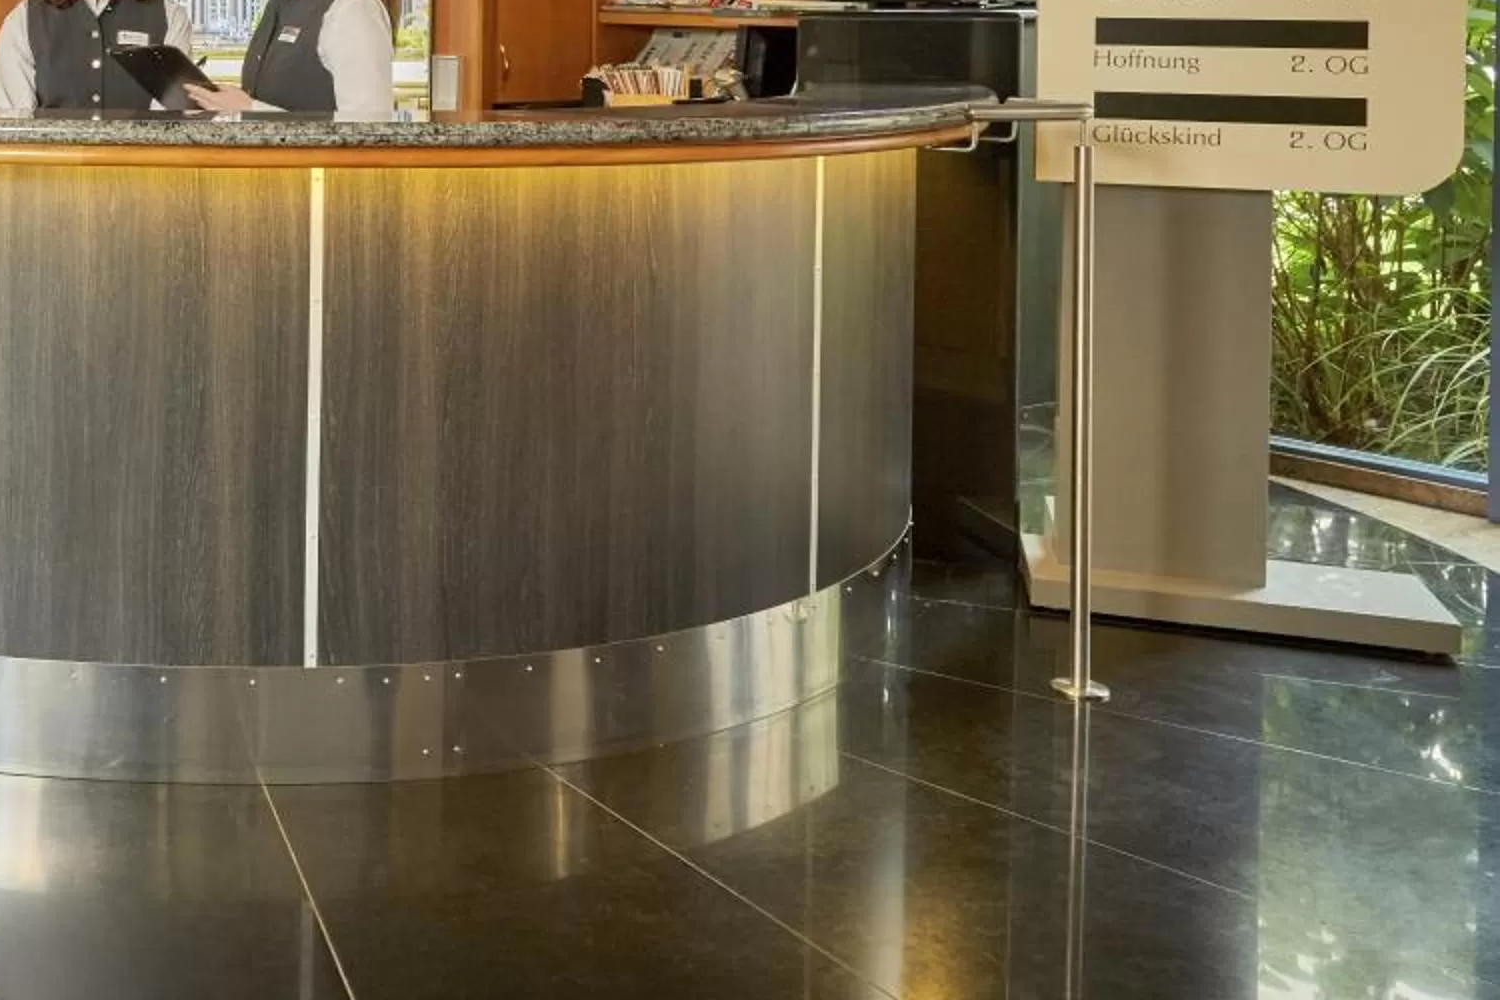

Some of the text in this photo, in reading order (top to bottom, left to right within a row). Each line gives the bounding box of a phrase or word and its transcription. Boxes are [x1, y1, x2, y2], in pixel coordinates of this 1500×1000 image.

[1093, 49, 1369, 75] Hoffnung 2. OG
[1092, 124, 1367, 151] Glückskind 2. OG
